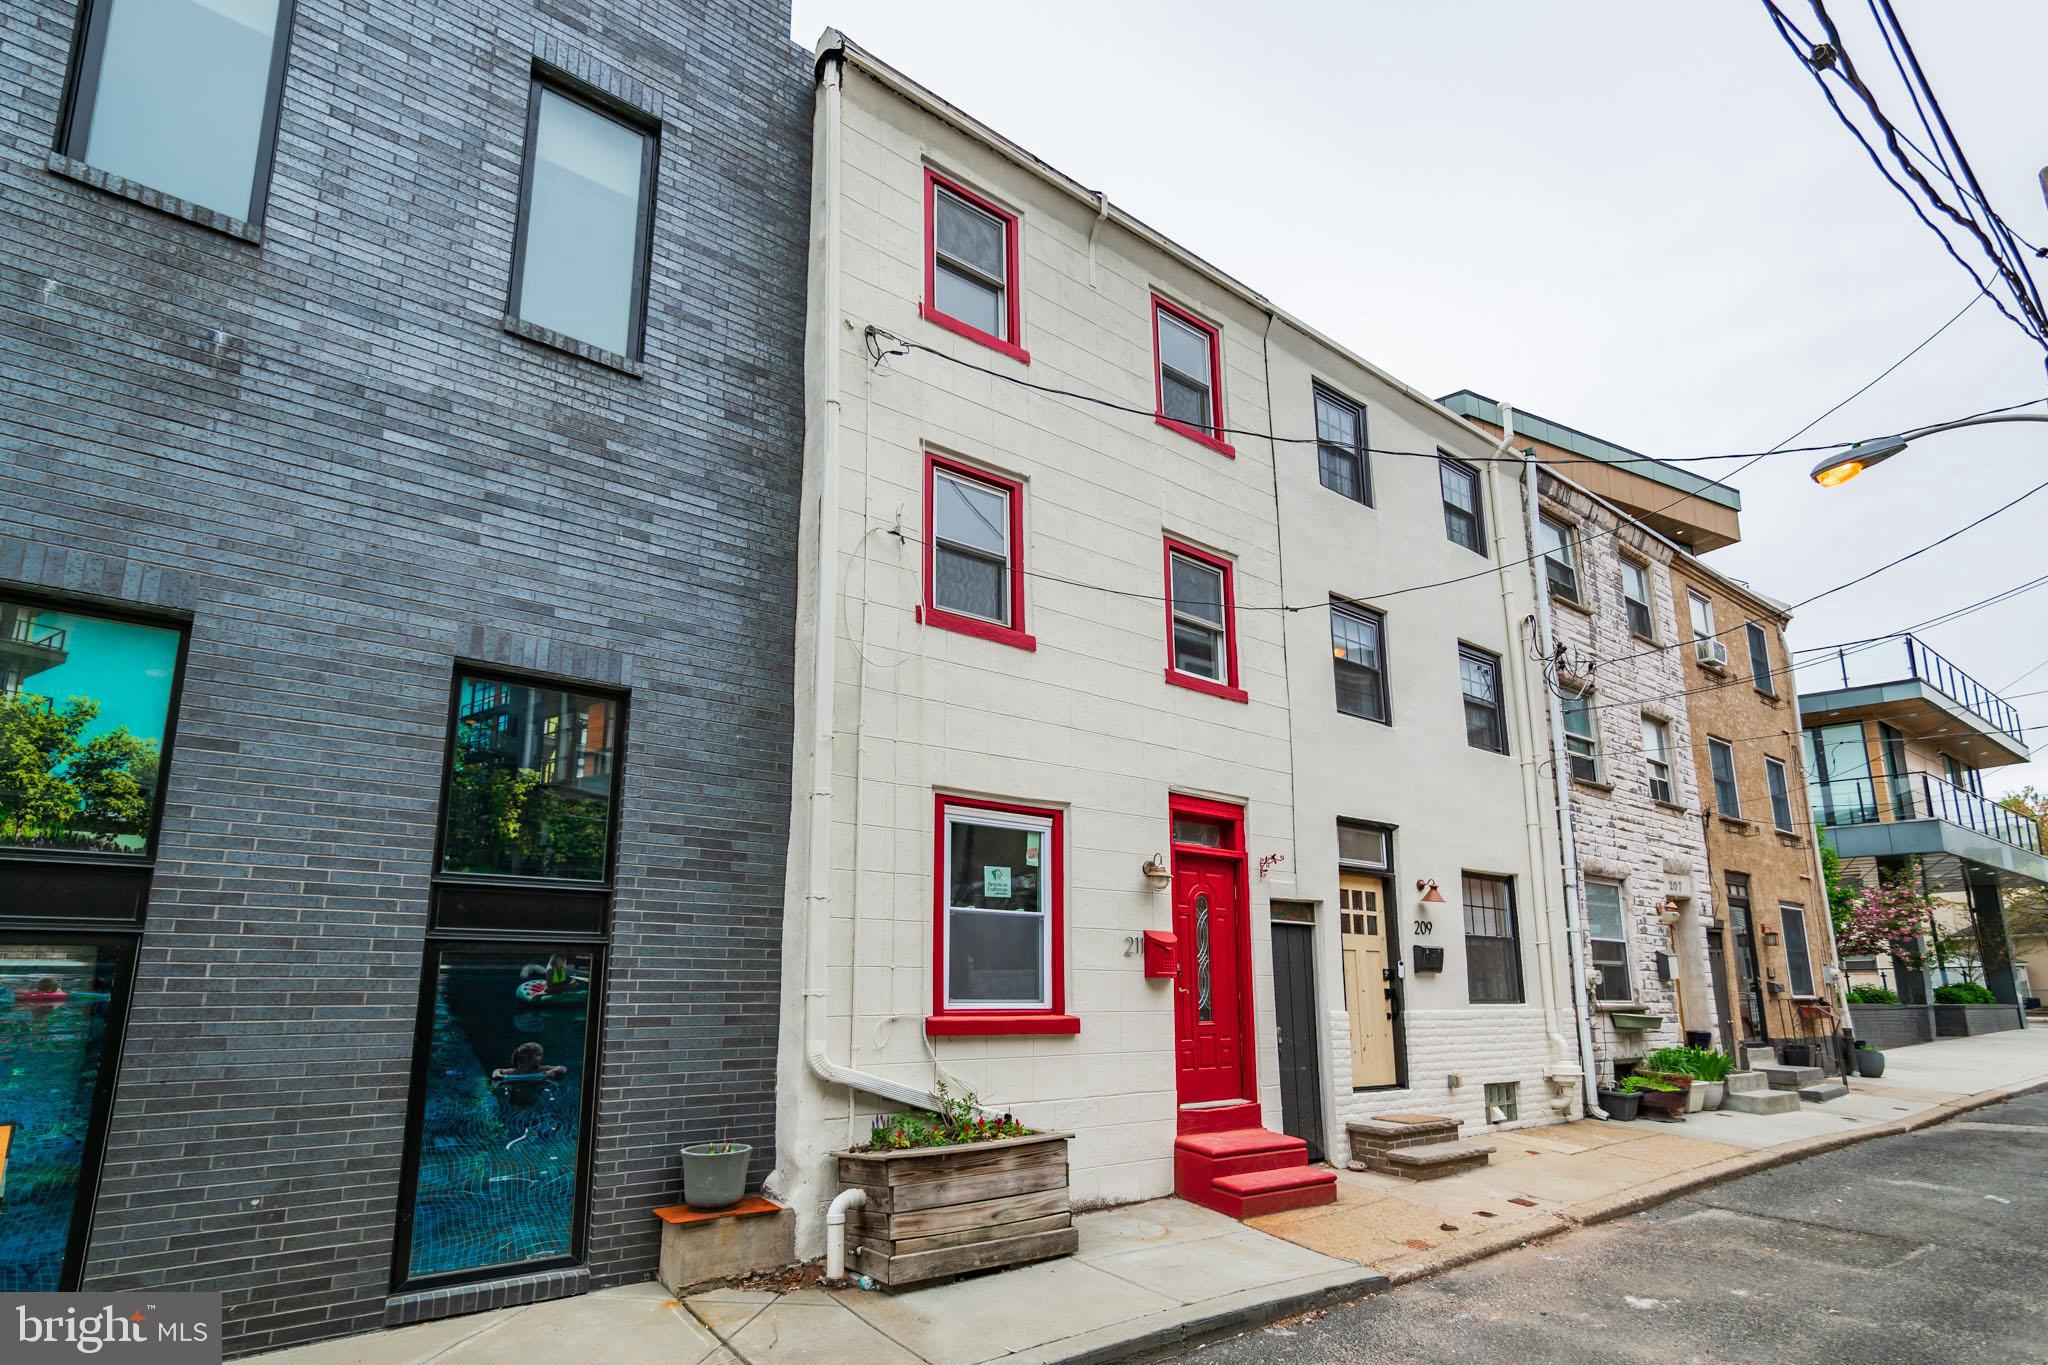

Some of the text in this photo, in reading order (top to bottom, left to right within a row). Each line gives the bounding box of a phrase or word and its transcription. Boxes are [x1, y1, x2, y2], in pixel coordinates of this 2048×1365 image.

[1668, 880, 1682, 891] 207
[1414, 920, 1433, 935] 209
[1124, 936, 1143, 957] 211
